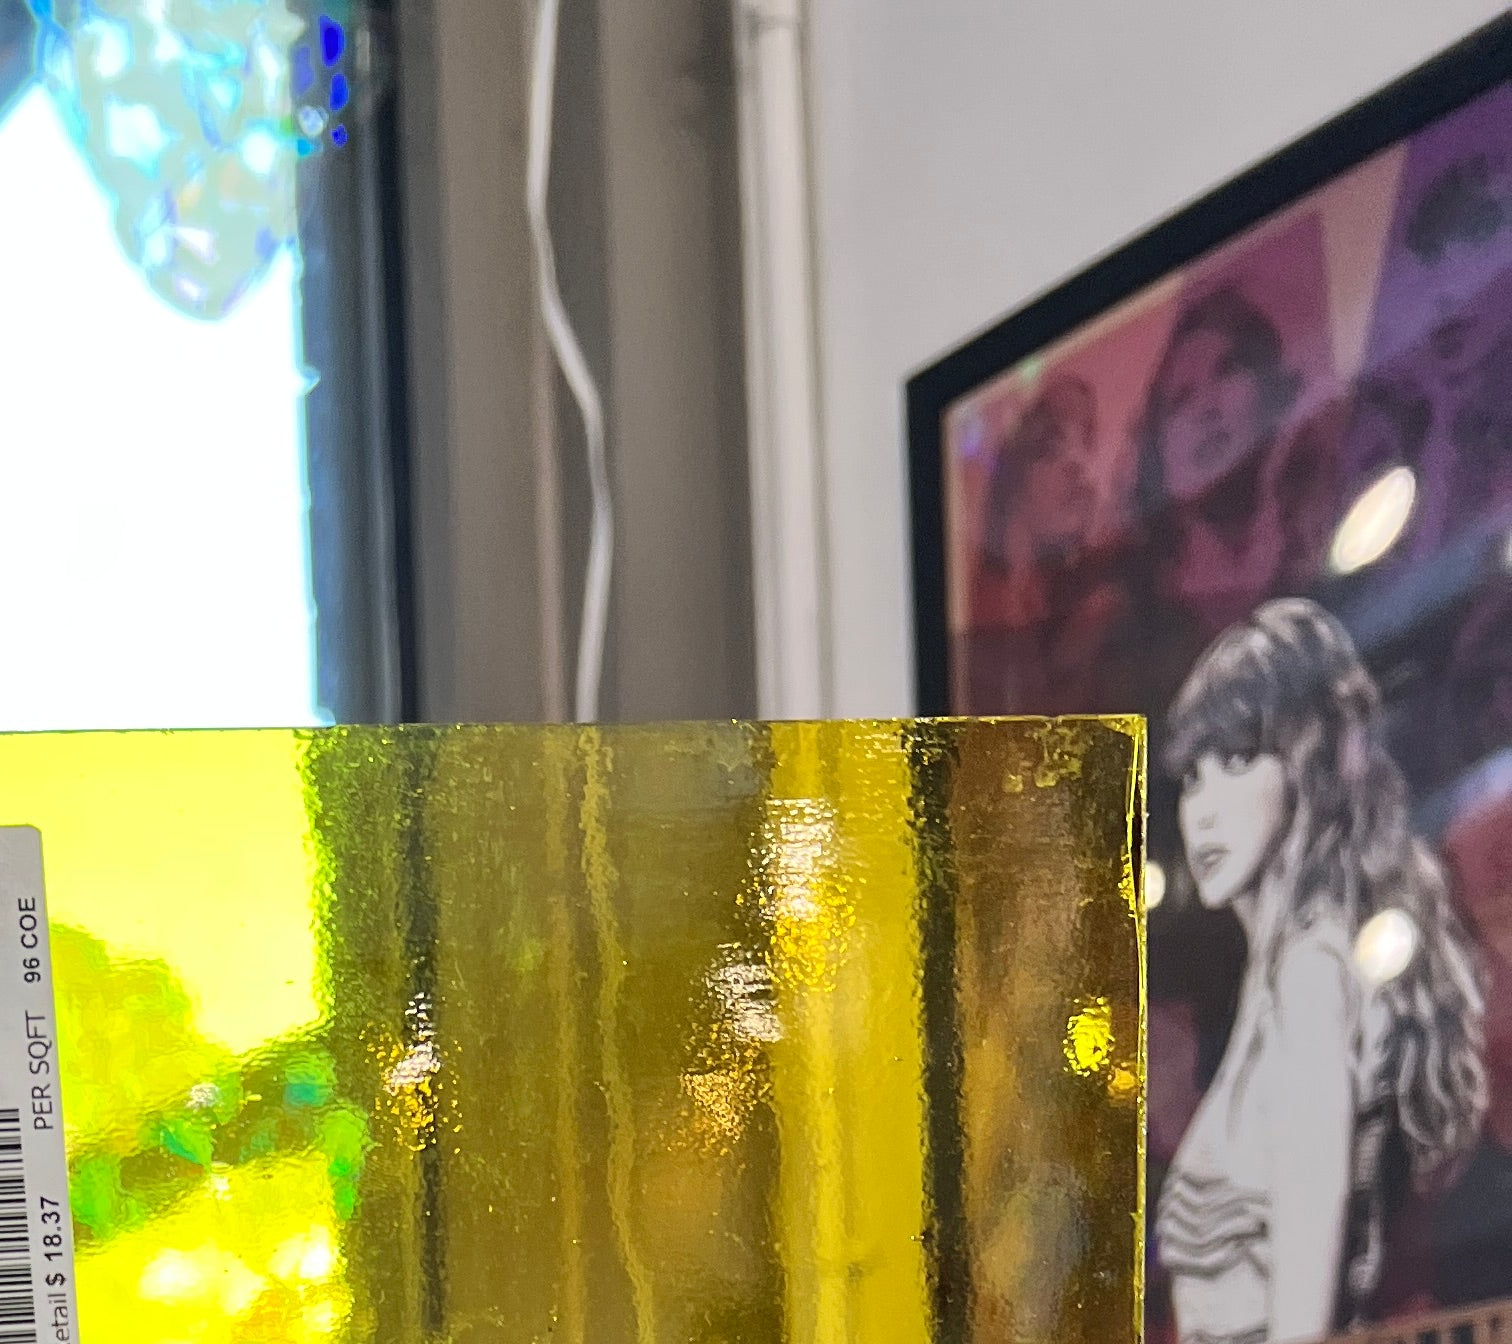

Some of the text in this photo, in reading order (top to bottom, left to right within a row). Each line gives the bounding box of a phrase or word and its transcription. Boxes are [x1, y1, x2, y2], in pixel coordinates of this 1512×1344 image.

[17, 896, 39, 950] COE
[22, 956, 42, 984] 96
[24, 1009, 53, 1076] SQFT
[31, 1082, 55, 1131] PER
[39, 1195, 63, 1262] 18.37
[44, 1272, 67, 1287] $
